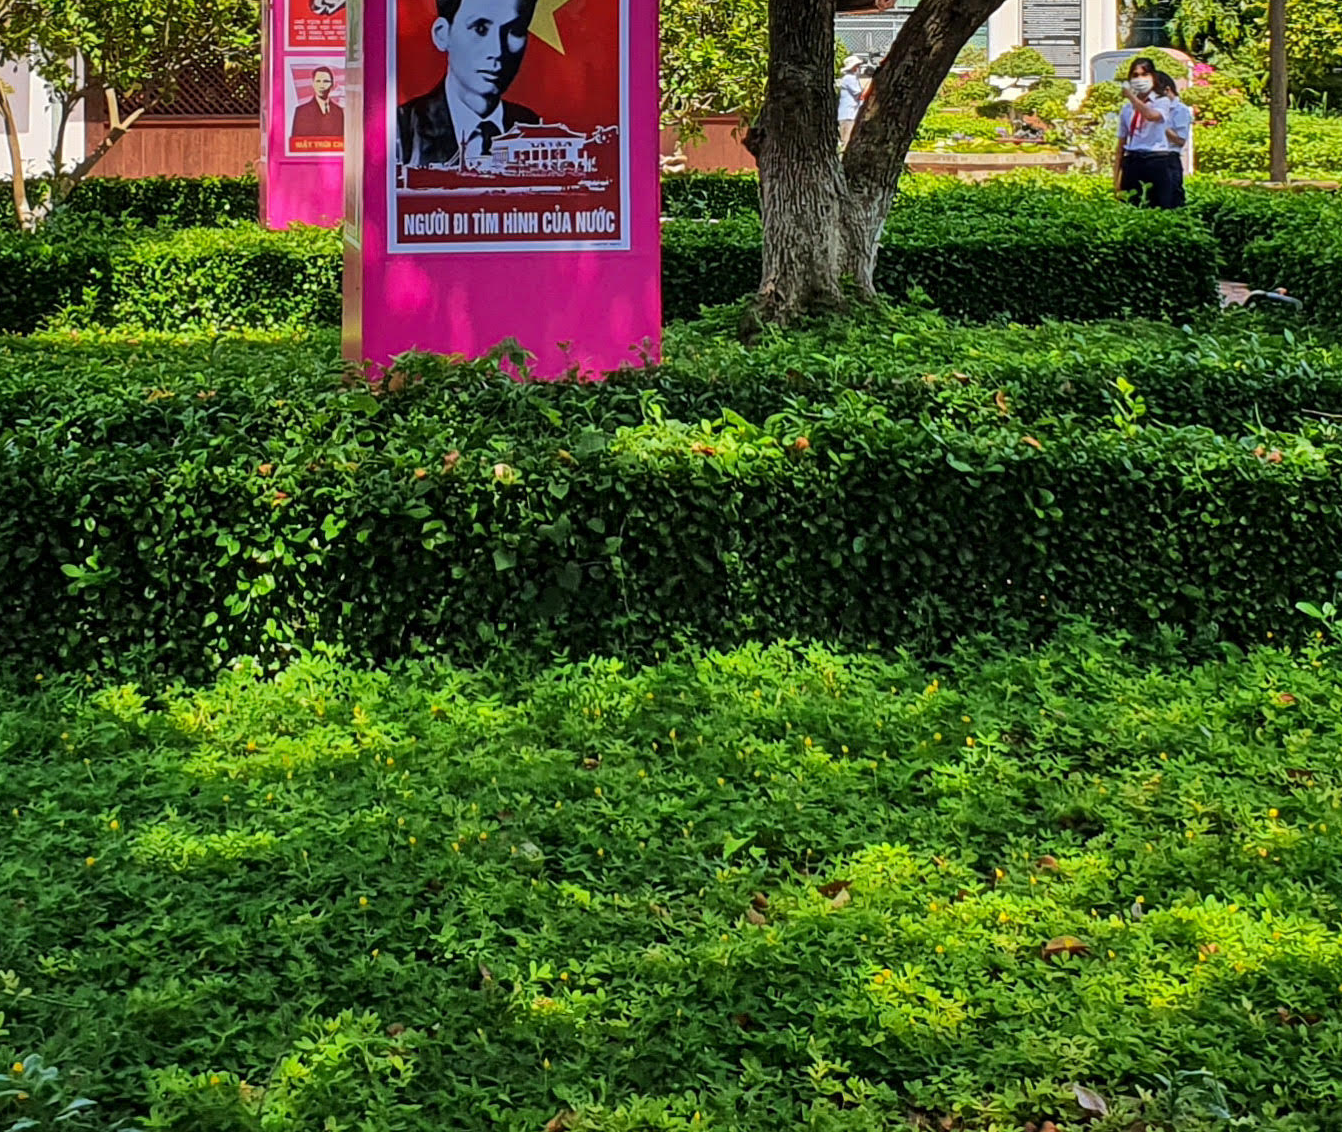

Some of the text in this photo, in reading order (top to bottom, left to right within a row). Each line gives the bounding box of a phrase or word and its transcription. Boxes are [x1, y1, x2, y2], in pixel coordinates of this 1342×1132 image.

[404, 205, 615, 236] NGƯỜI ĐI TÌM HÌNH CỦA NƯỚC
